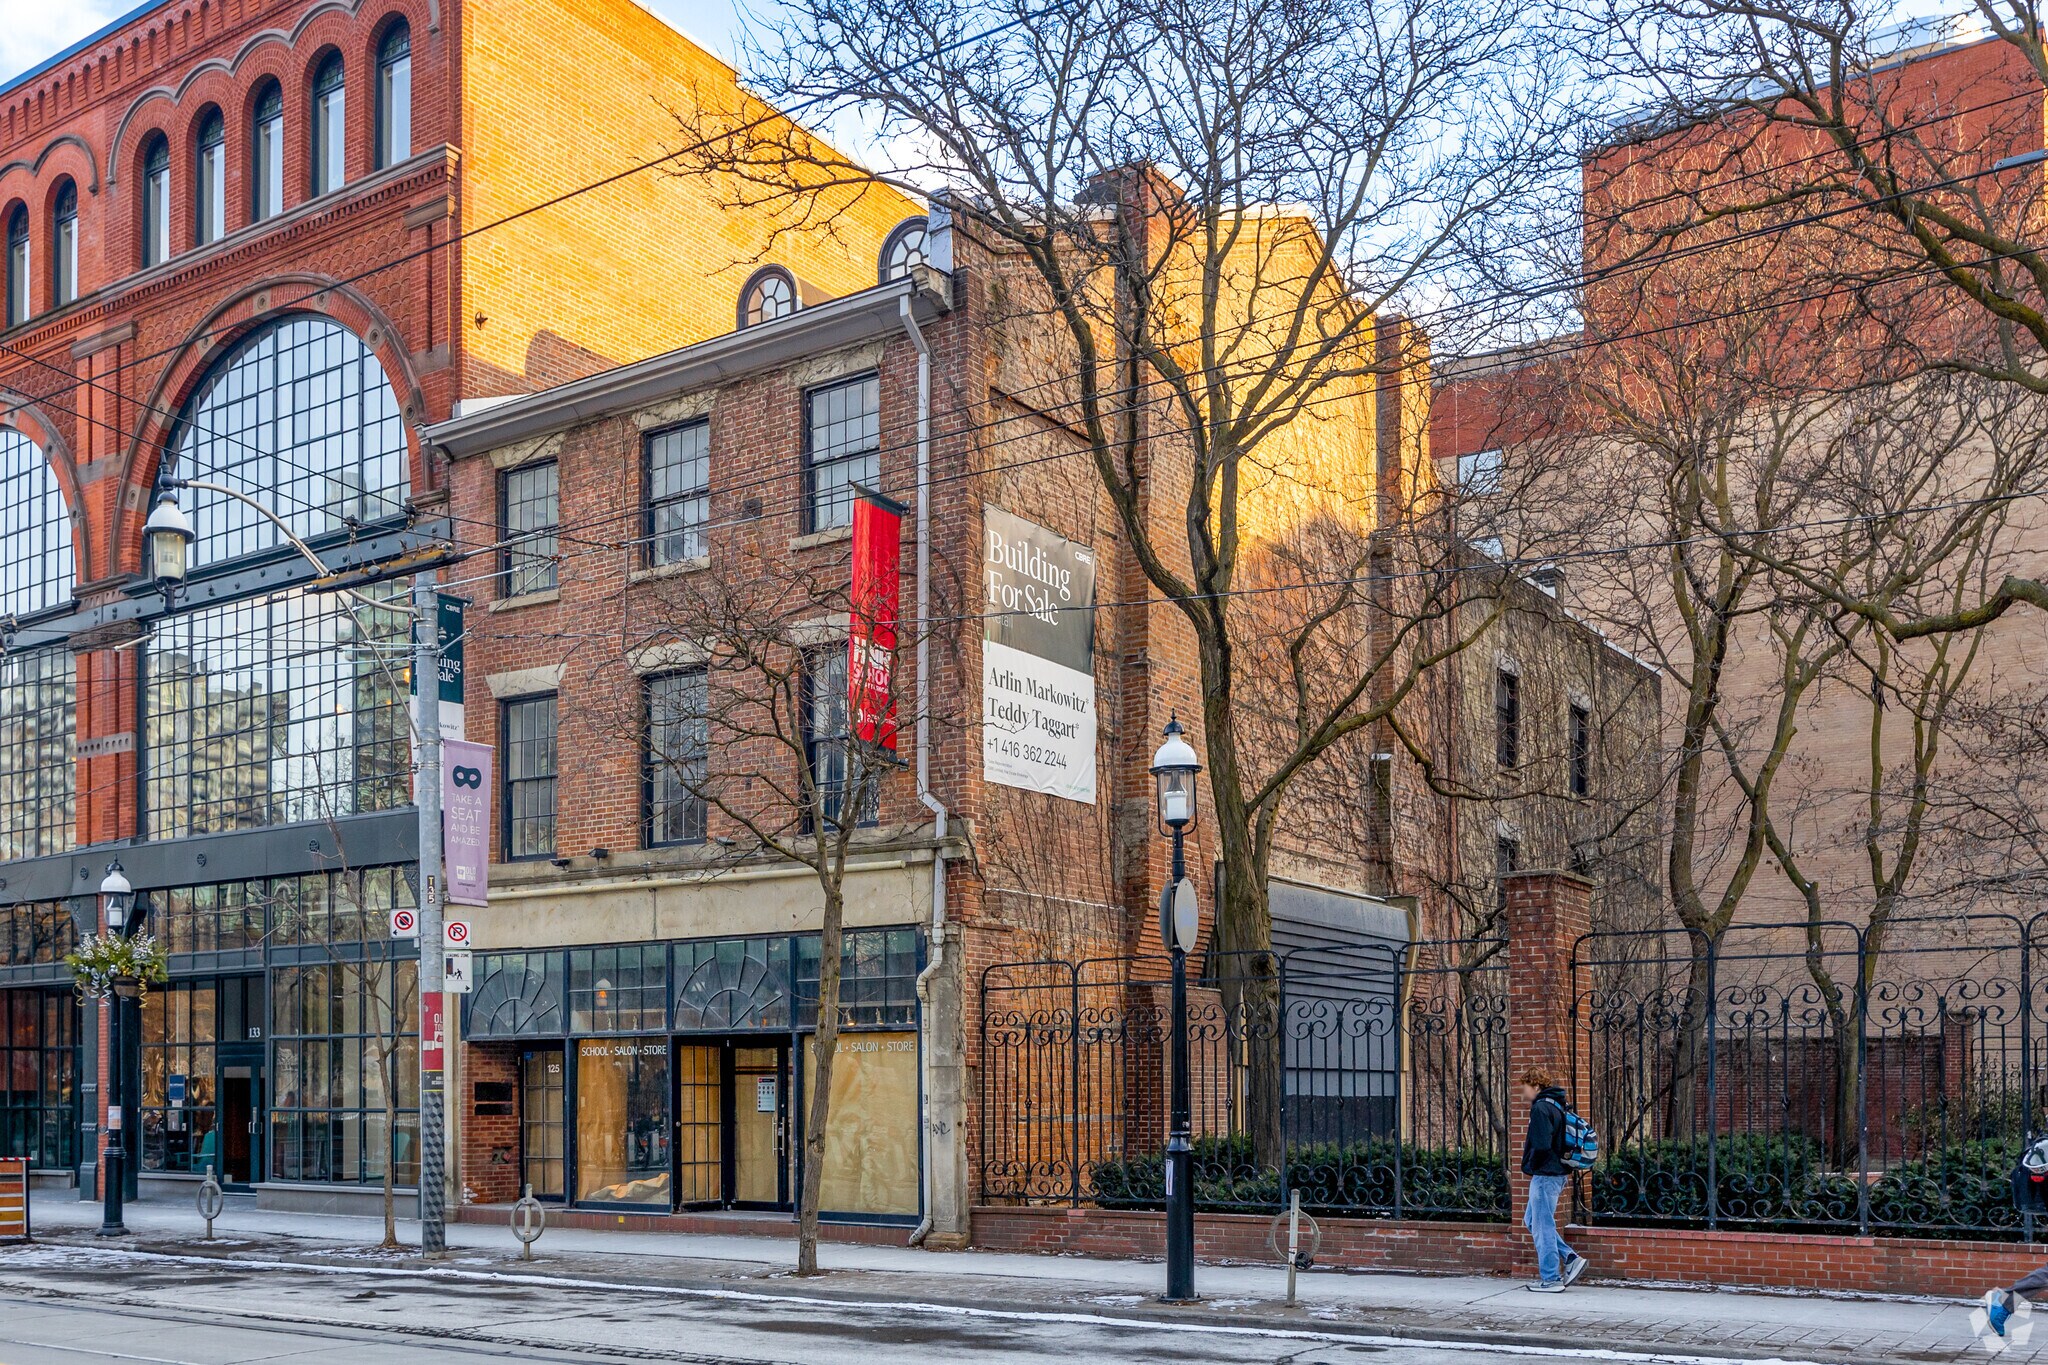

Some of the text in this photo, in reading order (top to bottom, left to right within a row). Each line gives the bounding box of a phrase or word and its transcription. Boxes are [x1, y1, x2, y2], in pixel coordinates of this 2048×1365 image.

[1074, 551, 1092, 566] CBRE
[986, 529, 1071, 602] Building
[987, 569, 1059, 626] For Sale
[445, 603, 461, 614] CBRE
[988, 667, 1022, 694] Arlin
[987, 696, 1030, 728] Teddy
[987, 737, 1067, 770] +1 416 362 2244
[451, 793, 482, 805] TAKE A
[451, 806, 482, 822] SEAT
[450, 823, 481, 836] AND BE
[450, 835, 480, 847] AMAZED
[248, 1027, 260, 1038] 133
[581, 1045, 667, 1057] SCHOOL SALON STORE
[850, 1041, 879, 1052] SALON
[886, 1041, 914, 1052] STORE
[547, 1063, 560, 1073] 125
